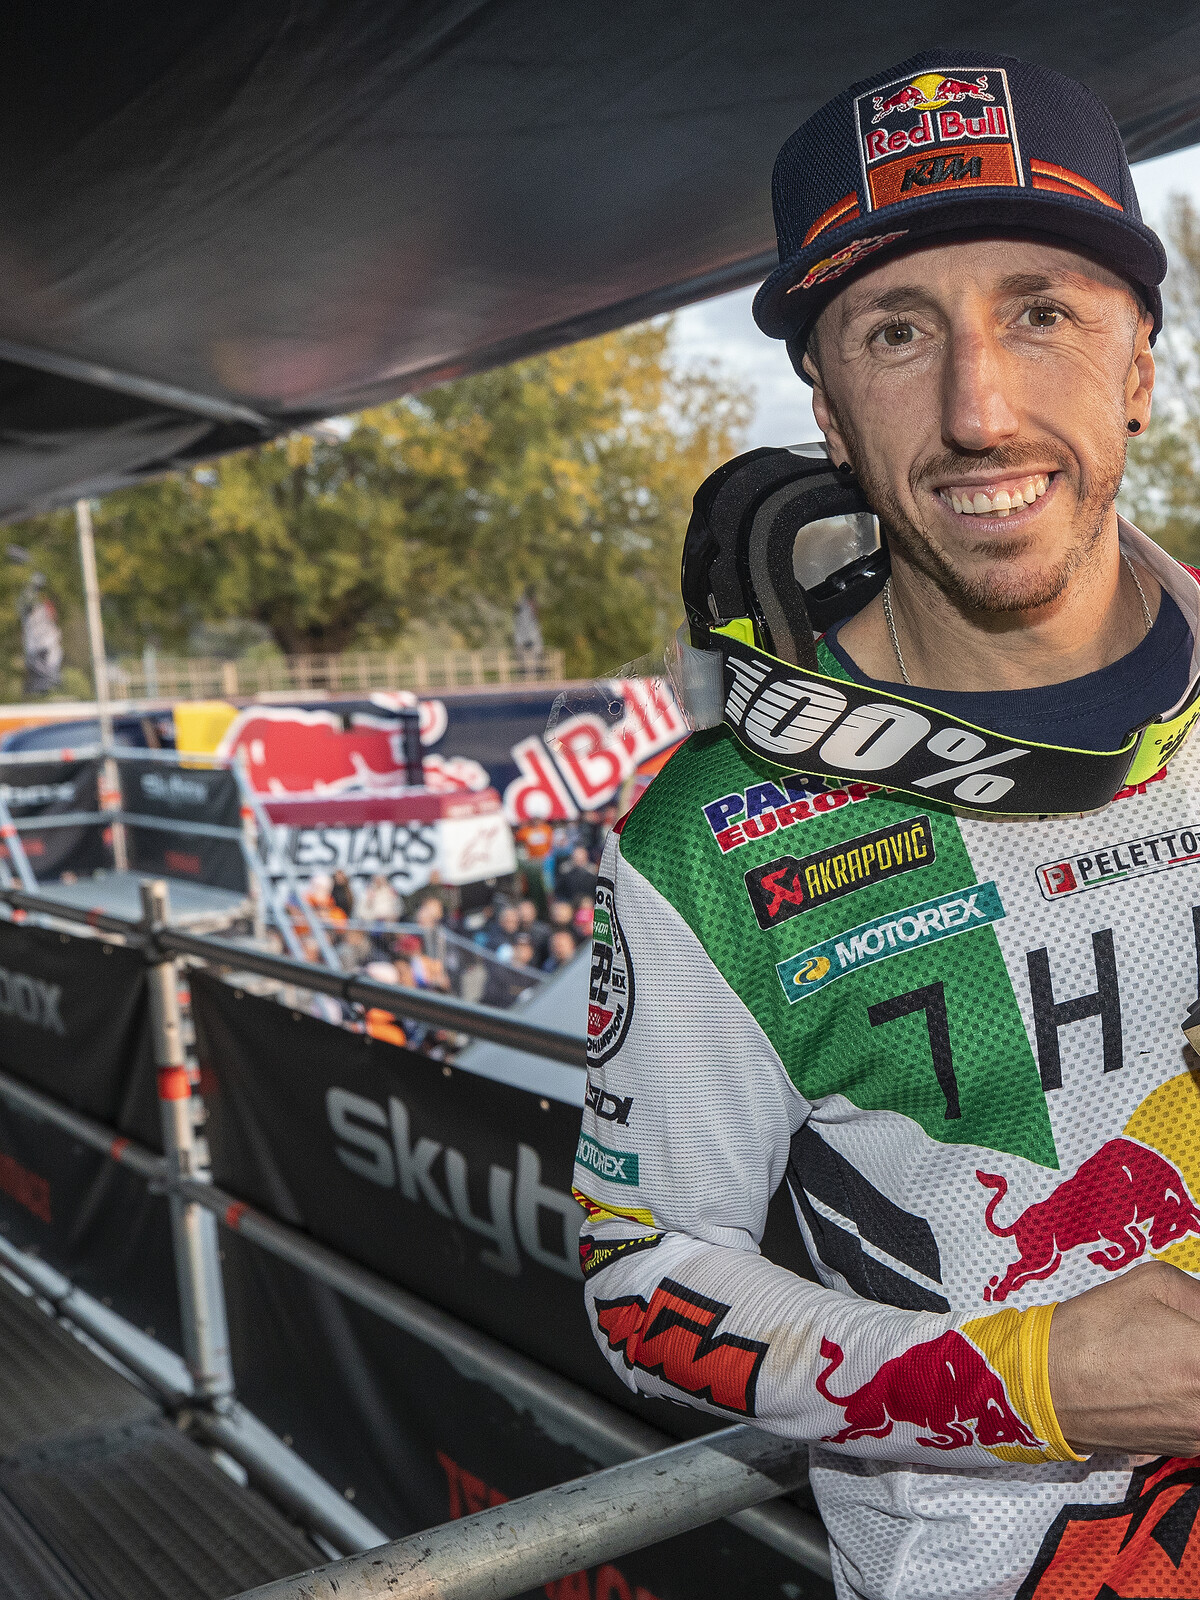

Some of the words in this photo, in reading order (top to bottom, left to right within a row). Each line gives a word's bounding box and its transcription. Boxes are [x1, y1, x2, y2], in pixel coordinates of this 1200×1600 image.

[864, 111, 934, 165] Red
[938, 106, 1010, 141] Bull
[900, 153, 984, 193] KTM
[723, 654, 1031, 804] 100%
[702, 773, 858, 834] PAR
[715, 783, 898, 853] EUROP
[805, 822, 928, 899] AKRAPOVIČ
[1078, 833, 1198, 882] PELETTO
[836, 893, 988, 971] MOTOREX
